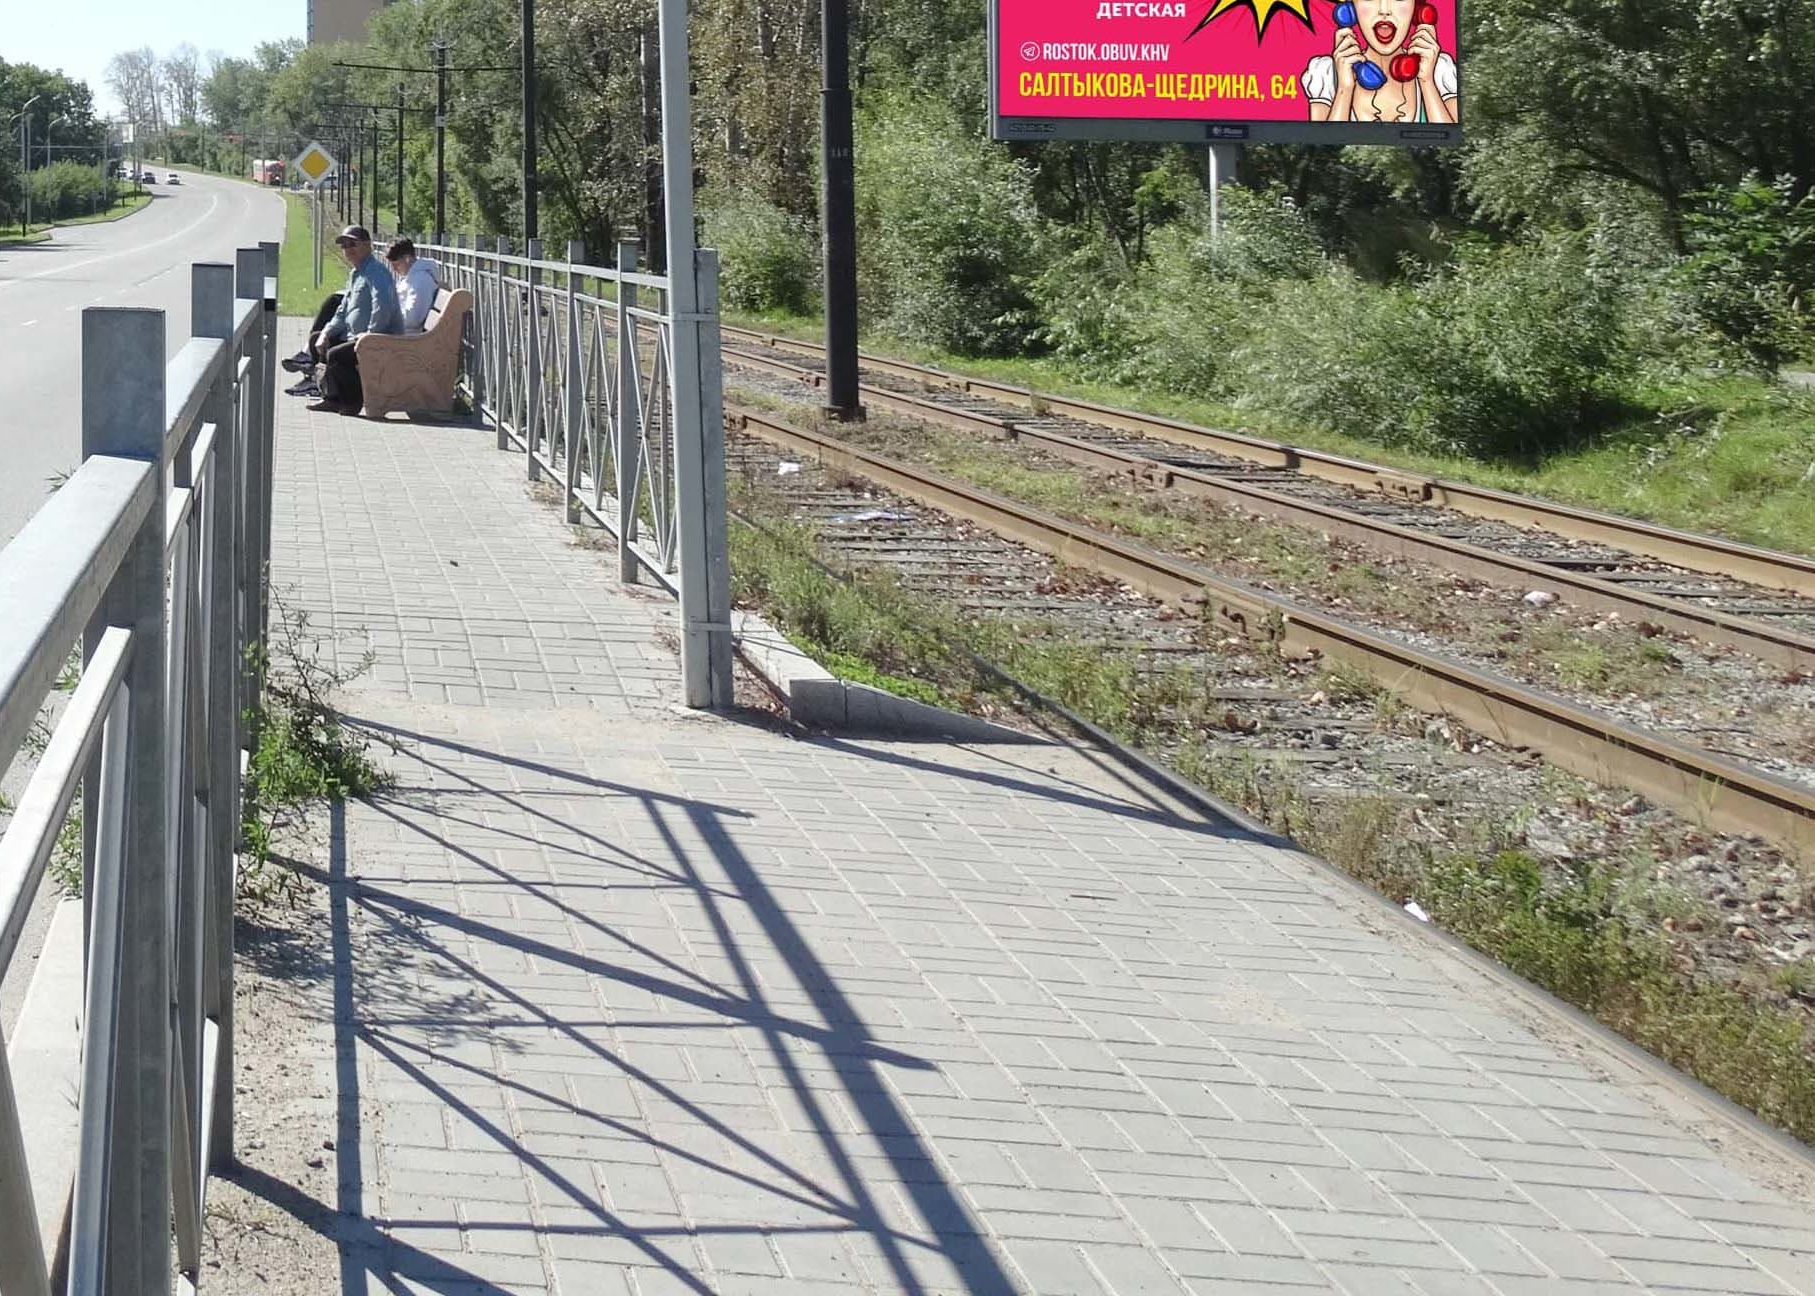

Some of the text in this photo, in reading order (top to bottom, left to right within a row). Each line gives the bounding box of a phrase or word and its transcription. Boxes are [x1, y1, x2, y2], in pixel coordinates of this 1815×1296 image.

[1096, 1, 1186, 19] ДЕТСКАЯ
[1042, 42, 1169, 62] ROSTOK.OBUV.KHV
[1019, 72, 1298, 102] САЛТЫКОВА-ЩЕДРИНА, 64
